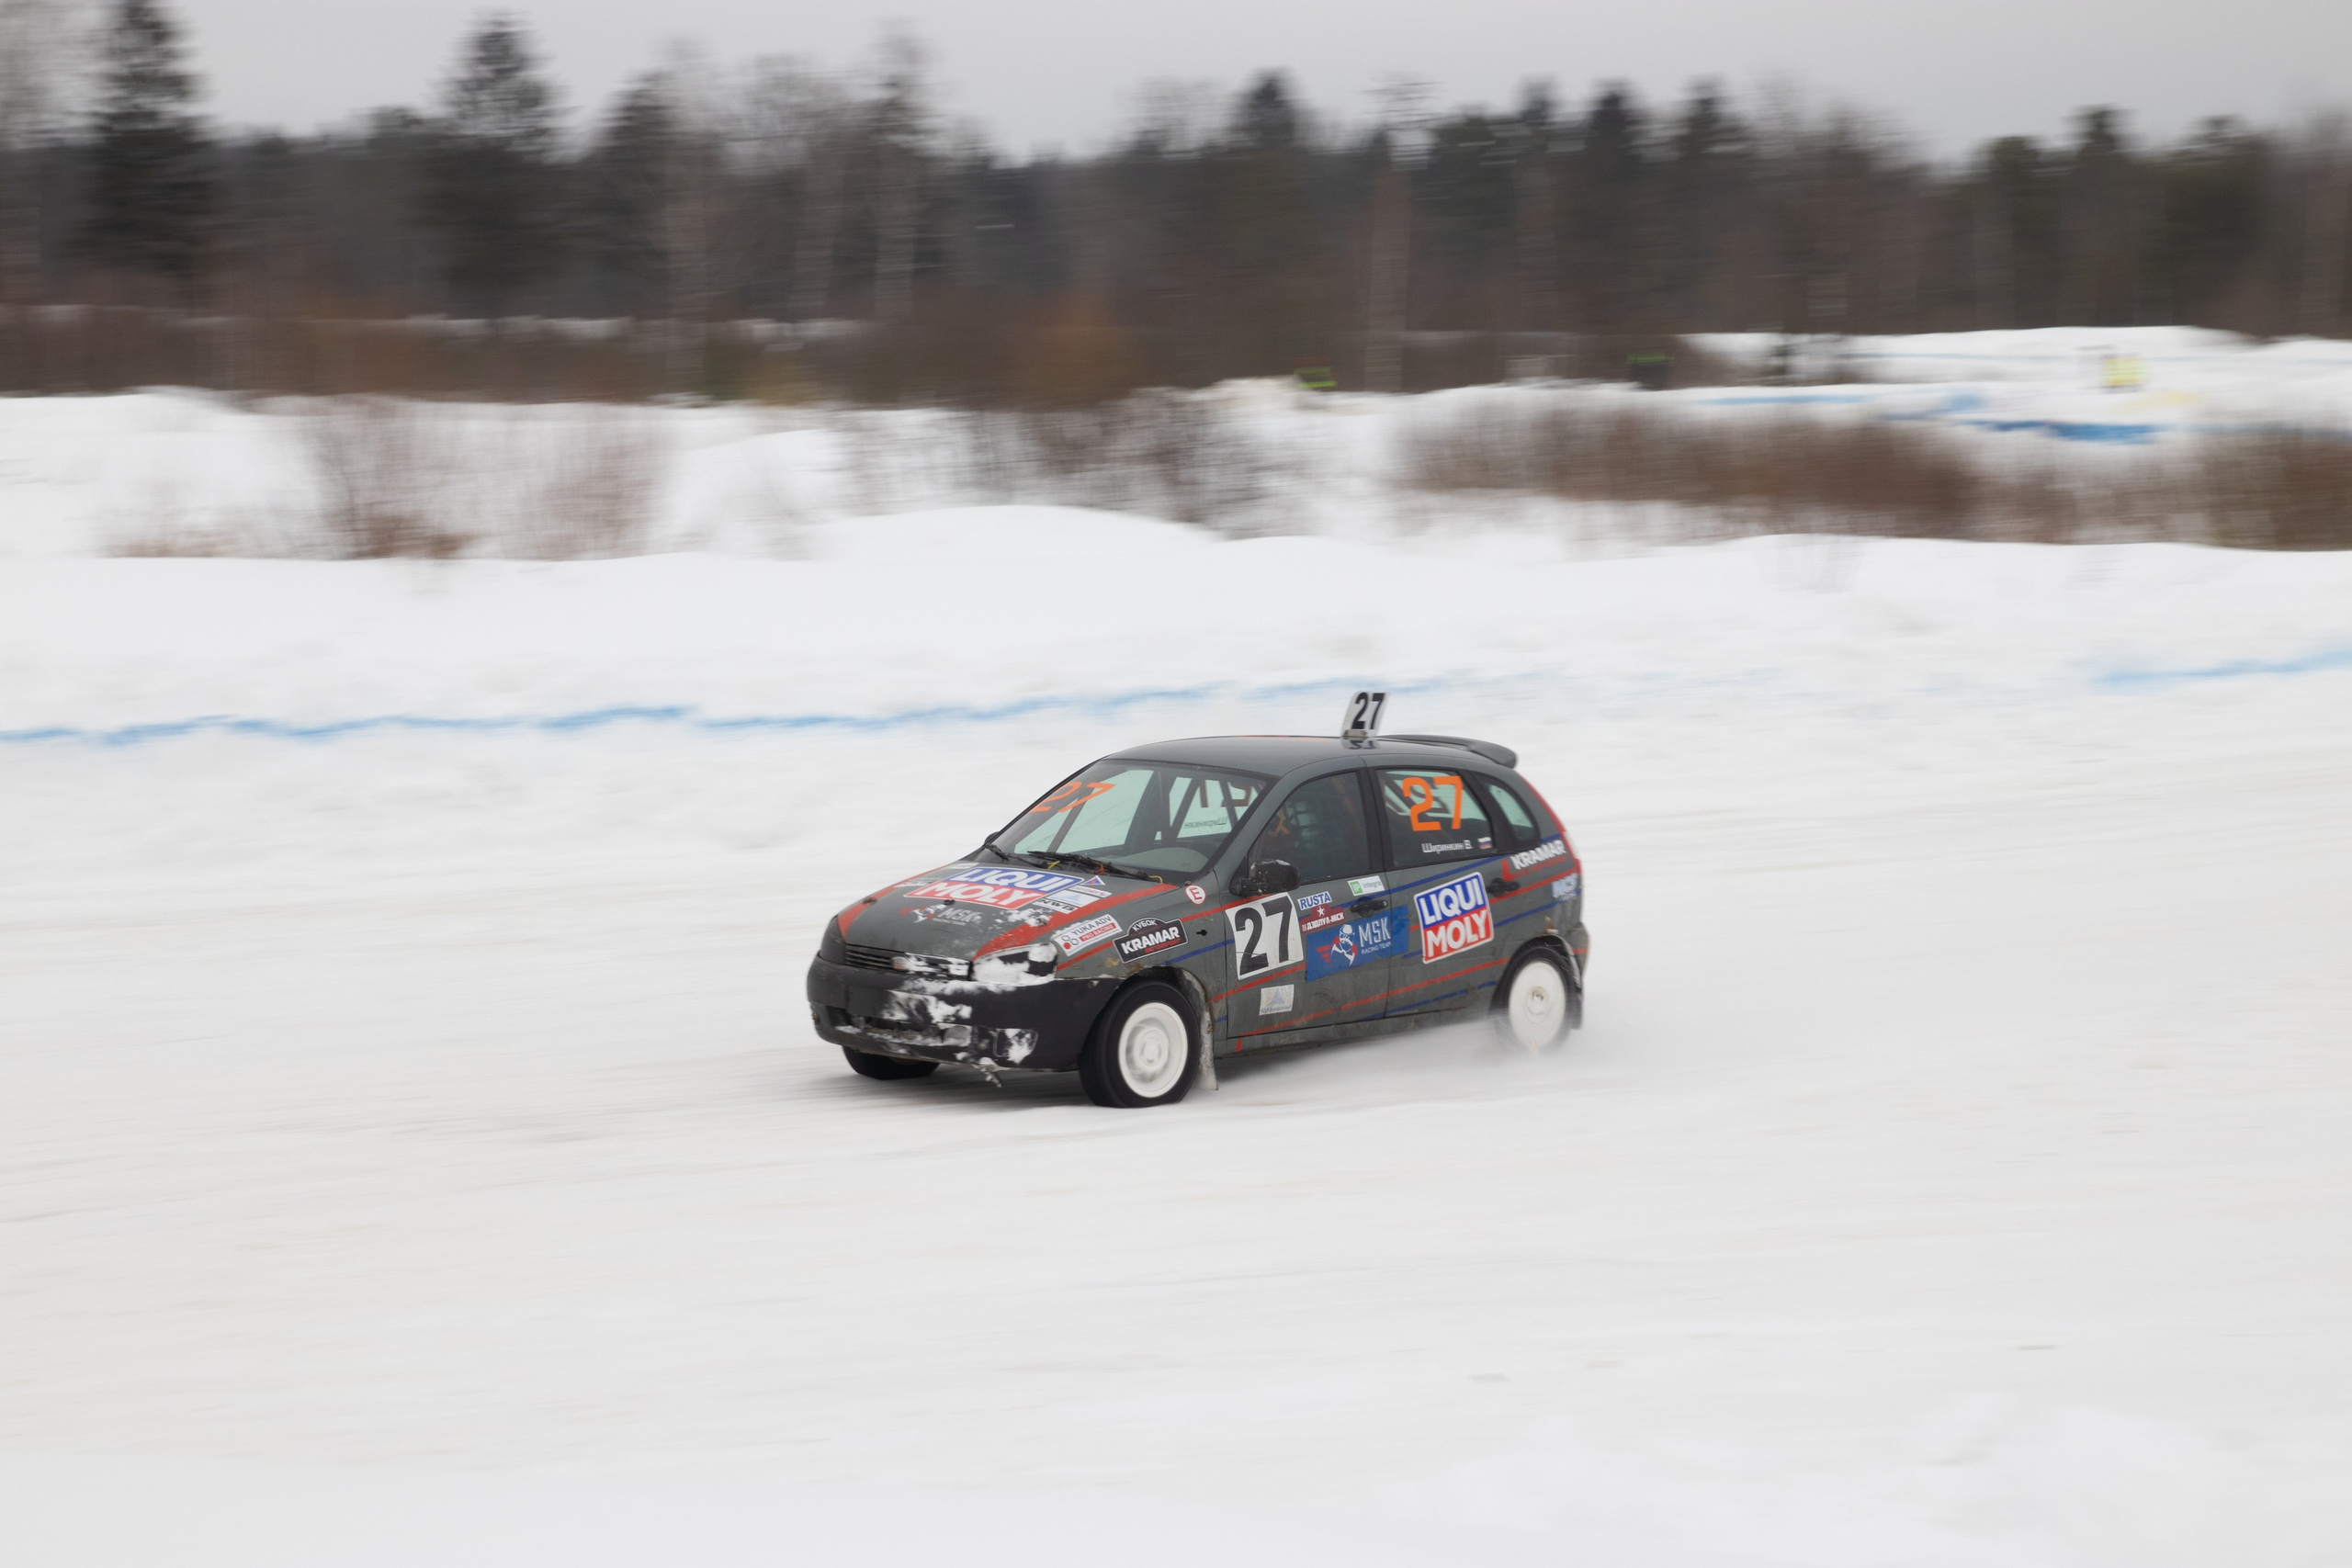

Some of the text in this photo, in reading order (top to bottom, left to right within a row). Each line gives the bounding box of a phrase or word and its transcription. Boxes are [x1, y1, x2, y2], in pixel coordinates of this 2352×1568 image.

[1351, 692, 1385, 730] 27
[1029, 781, 1116, 813] 27
[1402, 775, 1464, 831] 27
[1510, 840, 1567, 870] KRAMAR
[913, 881, 1044, 906] MOLY
[949, 867, 1075, 892] LIQUI
[1189, 887, 1203, 900] E
[1299, 892, 1331, 909] RUSTA
[1419, 878, 1484, 925] LIQUI
[1070, 915, 1112, 935] YUKA ADV
[1132, 919, 1158, 931] КУБОК
[1234, 895, 1293, 976] 27
[1358, 917, 1391, 947] MSK
[1426, 909, 1487, 957] MOLY
[1121, 927, 1181, 954] KRAMAR
[1361, 942, 1392, 954] RACING TEAM
